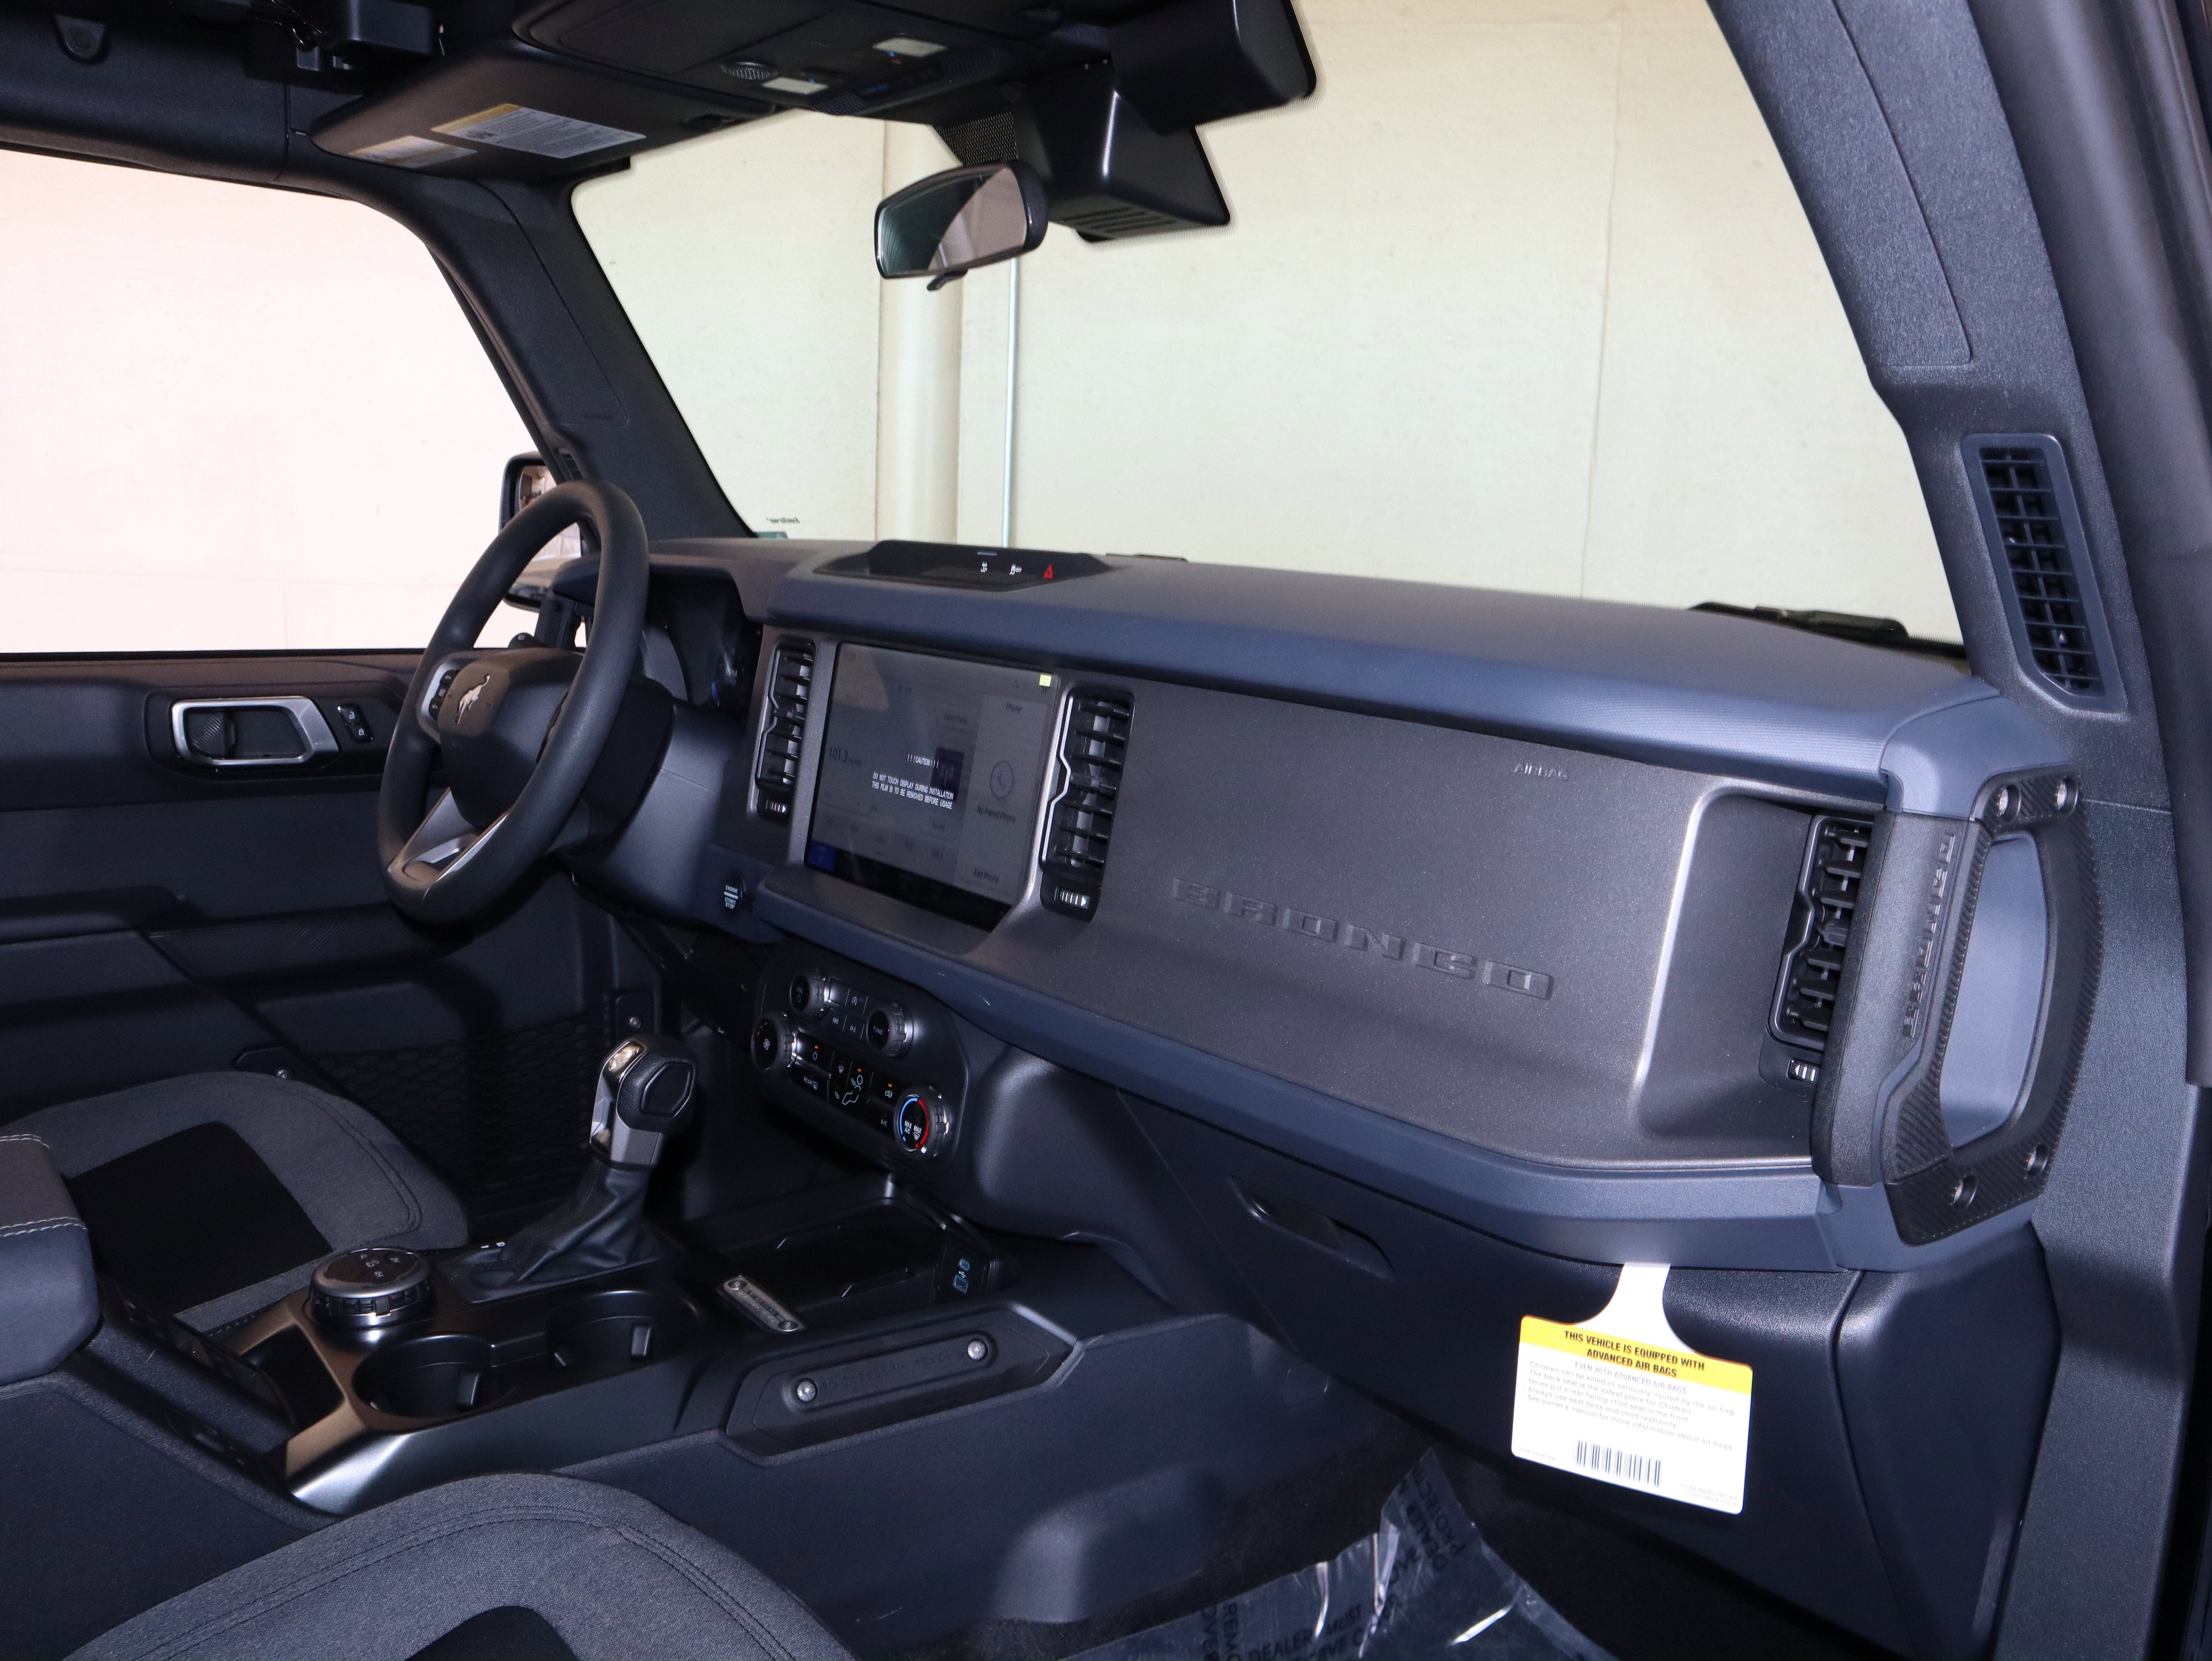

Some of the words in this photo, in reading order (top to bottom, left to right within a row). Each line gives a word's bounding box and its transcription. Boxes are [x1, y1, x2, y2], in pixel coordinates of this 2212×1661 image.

[830, 747, 848, 763] 101.3
[1514, 762, 1568, 781] AIRBAG
[880, 783, 889, 791] FILM
[906, 791, 923, 801] REMOVED
[924, 795, 939, 806] BEFORE
[940, 800, 952, 809] USAGE
[888, 776, 899, 785] TOUCH
[900, 779, 914, 789] DISPLAY
[915, 784, 928, 793] DURING
[929, 787, 954, 800] INSTALLATION
[1172, 877, 1555, 1000] BRONCO
[873, 1026, 883, 1035] TUNE
[803, 1077, 812, 1085] REAR
[913, 1124, 922, 1134] MAX
[1564, 1330, 1583, 1343] THIS
[1586, 1335, 1621, 1351] VEHICLE
[1623, 1344, 1632, 1354] IS
[1635, 1347, 1678, 1365] EQUIPPED
[1681, 1357, 1705, 1371] WITH
[1587, 1349, 1633, 1367] ADVANCED
[1635, 1360, 1650, 1371] AIR
[1653, 1364, 1677, 1377] BAGS
[1530, 1361, 1559, 1373] Children
[1587, 1375, 1605, 1385] killed
[1617, 1384, 1651, 1397] seriously
[1653, 1392, 1679, 1403] injured
[1720, 1406, 1736, 1416] bag.
[1575, 1362, 1592, 1372] EVEN
[1595, 1367, 1612, 1377] WITH
[1614, 1372, 1651, 1386] ADVANCED
[1653, 1381, 1665, 1389] AIR
[1668, 1384, 1686, 1394] BAGS
[1528, 1386, 1552, 1398] Always
[1570, 1397, 1584, 1406] seat
[1586, 1401, 1603, 1411] belts
[1621, 1411, 1639, 1419] child
[1529, 1378, 1548, 1387] Never
[1586, 1392, 1608, 1404] facing
[1610, 1399, 1627, 1408] child
[1671, 1413, 1690, 1423] front.
[1544, 1373, 1561, 1382] back
[1601, 1389, 1622, 1399] safest
[1625, 1394, 1644, 1403] place
[1659, 1401, 1693, 1415] Children.
[1571, 1406, 1597, 1418] manual
[1611, 1417, 1630, 1426] more
[1632, 1421, 1674, 1437] information
[1677, 1433, 1698, 1443] about
[1686, 1492, 1719, 1502] CUSTOMER
[1699, 1488, 1728, 1499] REMOVED
[1327, 1604, 1360, 1635] MUST
